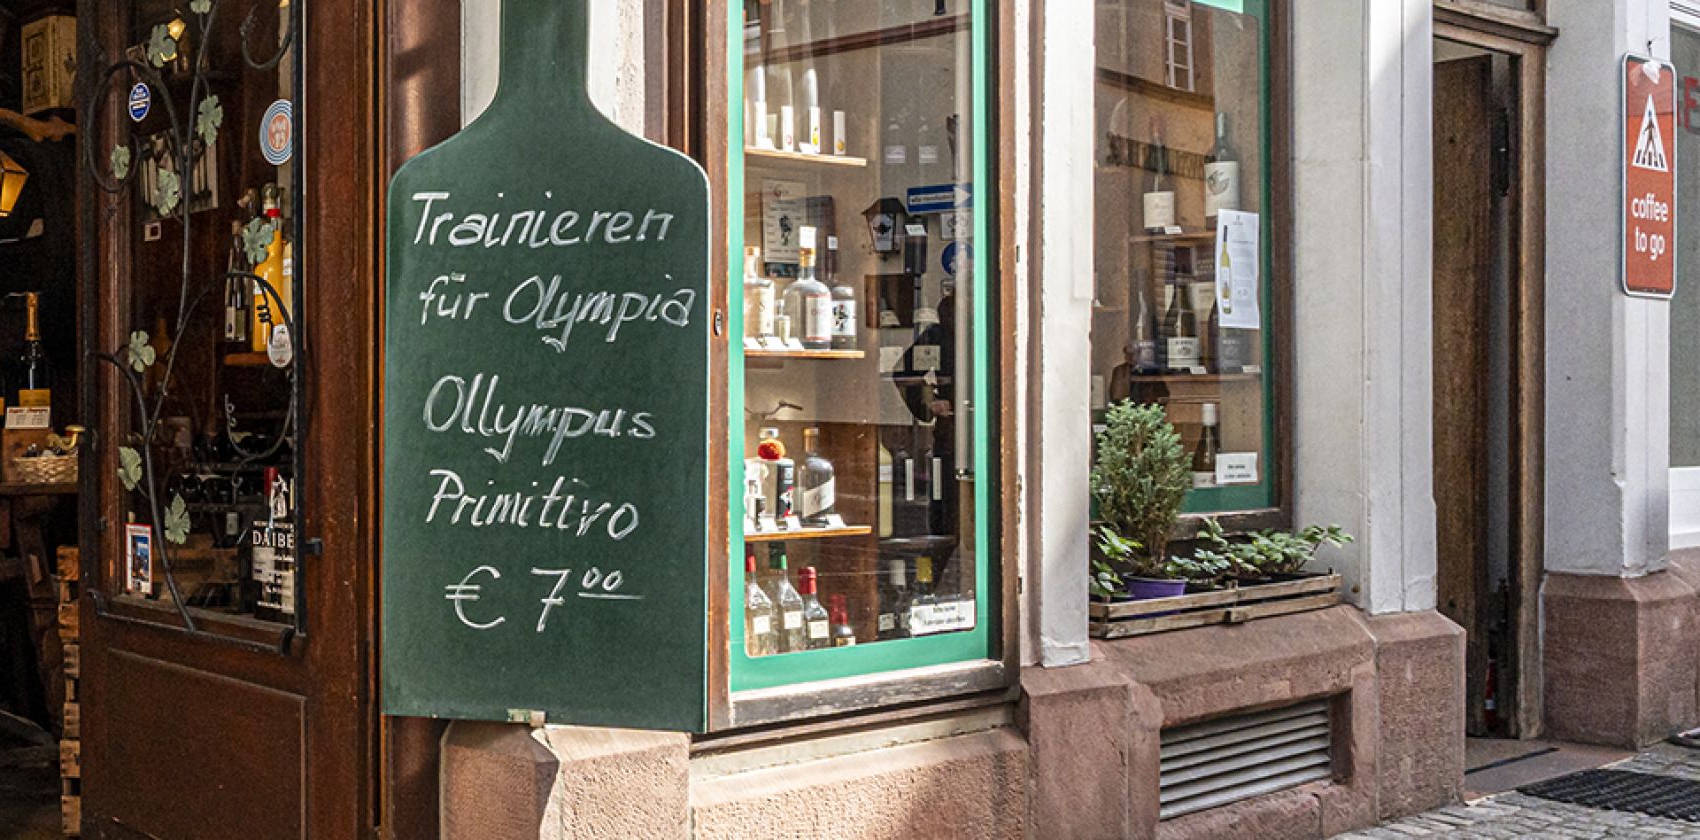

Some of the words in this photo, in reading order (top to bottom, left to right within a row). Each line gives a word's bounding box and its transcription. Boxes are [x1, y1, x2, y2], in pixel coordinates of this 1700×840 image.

[412, 190, 674, 249] Trainieren
[1632, 192, 1669, 222] coffee
[1635, 226, 1647, 253] to
[1650, 234, 1666, 261] go
[419, 272, 490, 326] für
[502, 273, 697, 353] Olympia
[422, 372, 657, 467] Ollympus
[426, 469, 640, 541] Primitivo
[444, 564, 506, 630] €
